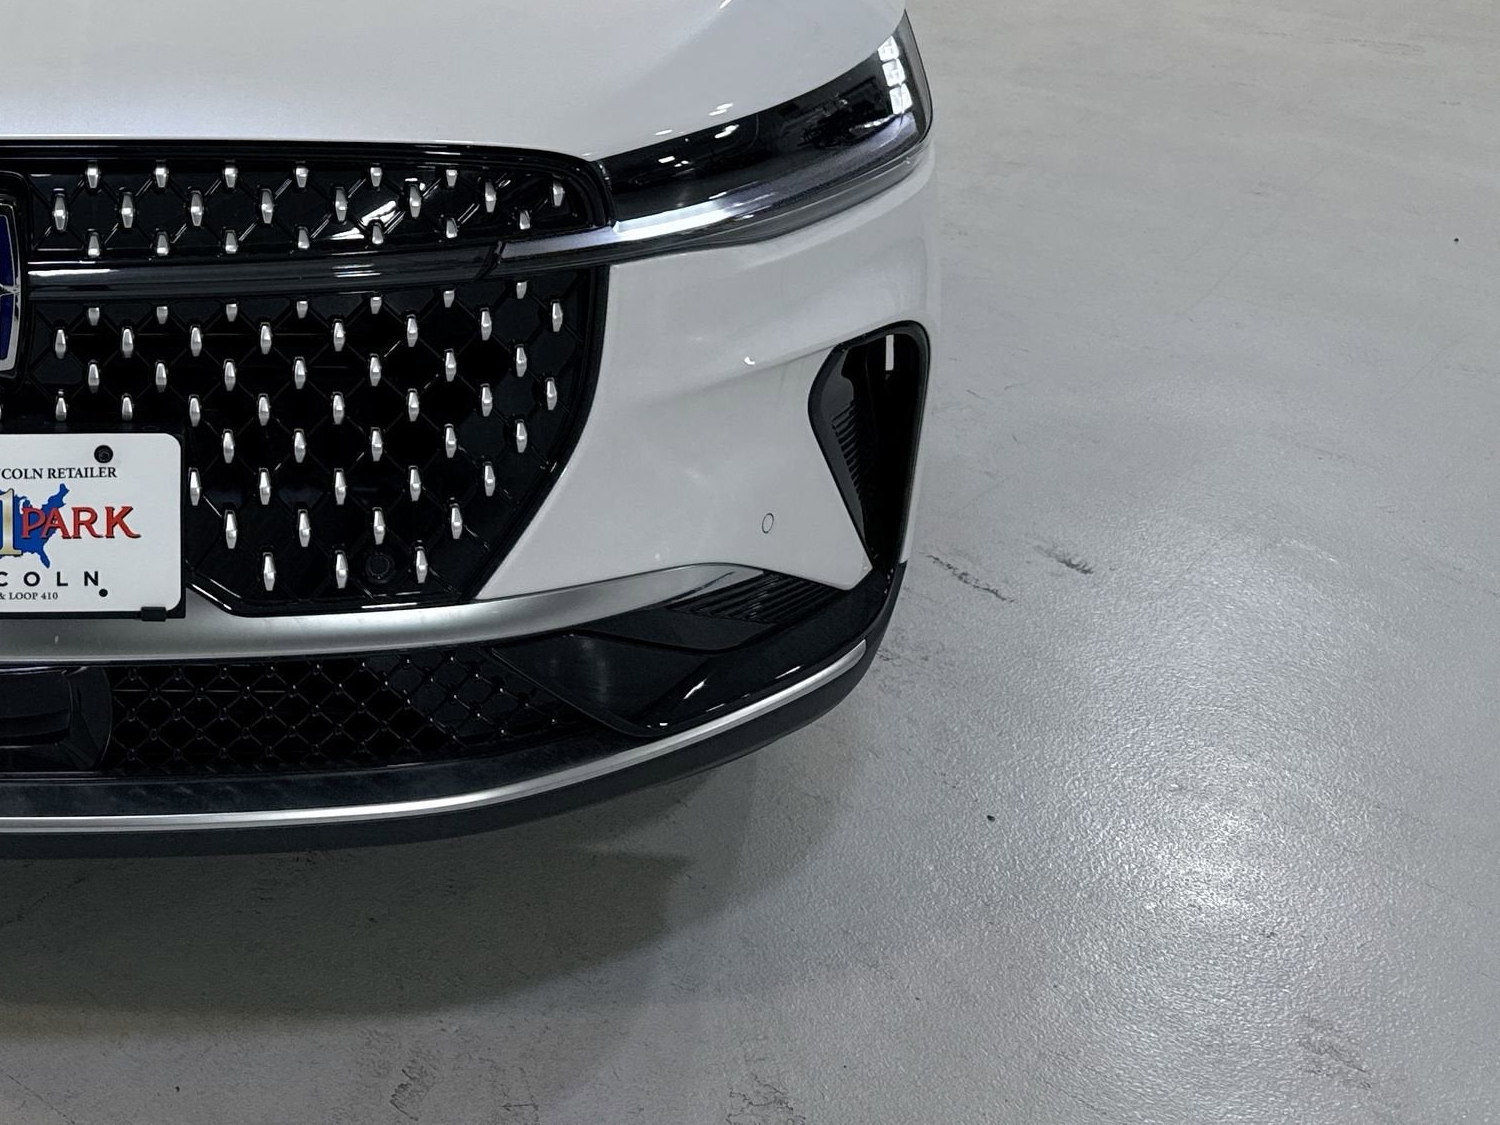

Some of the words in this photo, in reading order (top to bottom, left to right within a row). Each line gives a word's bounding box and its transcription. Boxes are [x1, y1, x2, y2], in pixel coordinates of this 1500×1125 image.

[47, 466, 118, 480] RETAILER
[21, 505, 142, 539] PARK
[8, 591, 39, 601] LOOP
[41, 591, 59, 601] 410
